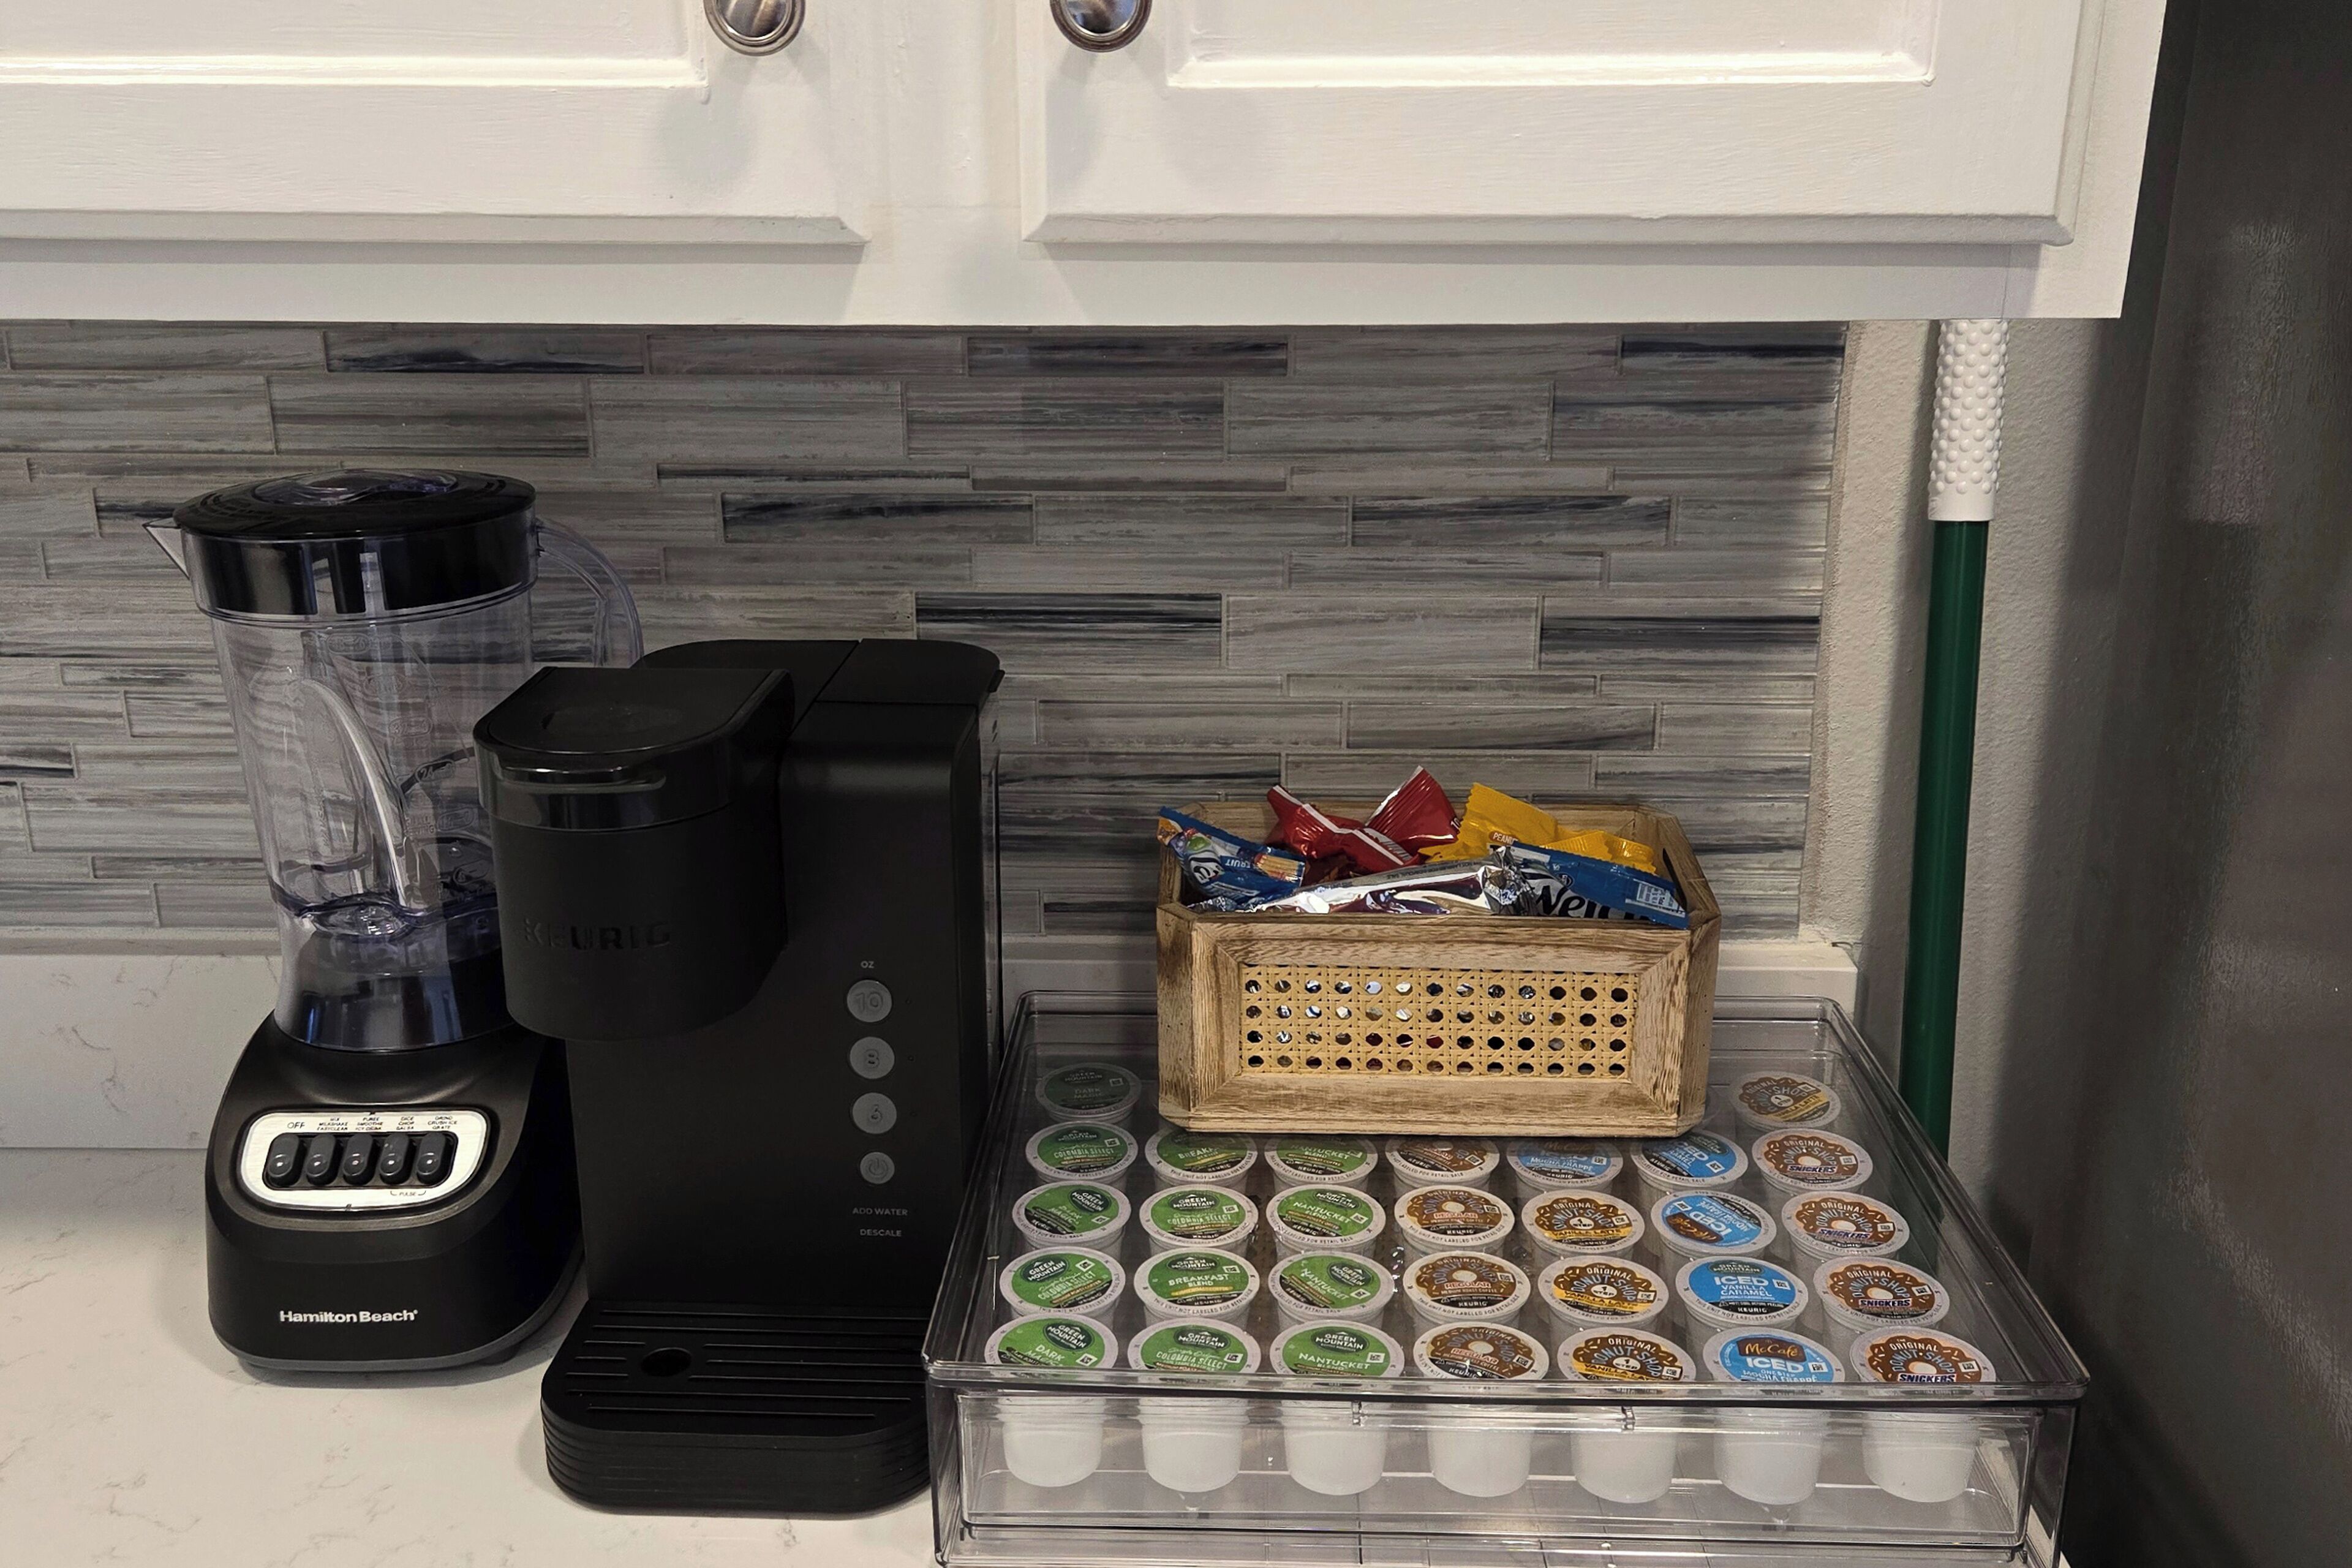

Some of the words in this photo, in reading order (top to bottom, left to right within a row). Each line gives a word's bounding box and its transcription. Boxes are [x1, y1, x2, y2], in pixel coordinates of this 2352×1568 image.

[1225, 859, 1251, 869] FRUIT
[524, 918, 673, 950] KEURIG
[855, 992, 883, 1012] 10
[865, 1048, 880, 1068] 8
[1746, 1080, 1777, 1094] ORIGINAL
[1772, 1085, 1807, 1098] SHOP
[1054, 1149, 1089, 1159] COLOMBIA
[1290, 1144, 1351, 1161] NANTUCKET
[1297, 1165, 1324, 1175] KEURIG
[1789, 1164, 1837, 1174] SNICKERS
[1072, 1191, 1104, 1212] MOUNTAIN
[1082, 1192, 1104, 1206] GREEN
[1316, 1193, 1356, 1209] MOUNTAIN
[1325, 1191, 1354, 1202] GREEN
[1422, 1194, 1452, 1215] DONUT
[1456, 1194, 1485, 1214] SHOP
[1553, 1201, 1598, 1210] ORIGINAL
[1820, 1201, 1865, 1215] ORIGINAL
[1205, 1213, 1232, 1222] SELECT
[1293, 1201, 1352, 1224] NANTUCKET
[1305, 1210, 1329, 1220] BLEND
[1583, 1208, 1615, 1229] SHOP
[1689, 1211, 1733, 1236] ICED
[1815, 1208, 1847, 1228] DONUT
[1848, 1212, 1874, 1233] SHOP
[859, 1229, 902, 1237] DESCALE
[1292, 1224, 1318, 1236] KEURIG
[1818, 1228, 1871, 1240] SNICKERS
[1028, 1261, 1066, 1281] MOUNTAIN
[1029, 1260, 1056, 1275] GREEN
[1341, 1266, 1366, 1280] GREEN
[1432, 1262, 1463, 1285] DONUT
[1467, 1263, 1498, 1284] SHOP
[1586, 1267, 1632, 1281] ORIGINAL
[1846, 1269, 1893, 1278] ORIGINAL
[1168, 1273, 1231, 1287] BREAKFAST
[1330, 1265, 1365, 1286] MOUNTAIN
[1714, 1275, 1769, 1286] ICED
[1038, 1280, 1073, 1300] COLOMBIA
[1073, 1270, 1096, 1285] SELECT
[1300, 1267, 1351, 1300] NANTUCKET
[1570, 1274, 1611, 1292] DONUT
[1613, 1278, 1637, 1302] SHOP
[1849, 1276, 1876, 1298] DONUT
[1877, 1277, 1912, 1299] SHOP
[1564, 1291, 1605, 1304] VANILLA
[1607, 1298, 1639, 1308] LATTE
[1860, 1298, 1912, 1307] SNICKERS
[279, 1310, 358, 1323] Hamilton
[1191, 1306, 1219, 1315] LABELED
[1047, 1326, 1088, 1349] MOUNTAIN
[1058, 1325, 1086, 1341] GREEN
[1188, 1333, 1219, 1342] GREEN
[1324, 1333, 1358, 1343] GREEN
[1446, 1332, 1494, 1348] DONUT
[1471, 1327, 1518, 1343] ORIGINAL
[1177, 1335, 1226, 1348] MOUNTAIN
[1315, 1336, 1364, 1350] MOUNTAIN
[1608, 1337, 1657, 1354] ORIGINAL
[1889, 1341, 1939, 1352] ORIGINAL
[1035, 1344, 1066, 1362] DARK
[1450, 1348, 1499, 1365] REGULAR
[1744, 1342, 1799, 1359] McCafé
[1025, 1350, 1064, 1366] MAGIC
[1155, 1351, 1196, 1363] COLOMBIA
[1198, 1357, 1229, 1370] SELECT
[1298, 1352, 1371, 1370] NANTUCKET
[1591, 1345, 1635, 1365] DONUT
[1636, 1351, 1664, 1378] SHOP
[1746, 1357, 1804, 1373] ICED
[1889, 1349, 1920, 1373] DONUT
[1923, 1351, 1956, 1374] SHOP
[1316, 1363, 1345, 1371] BLEND
[1448, 1367, 1480, 1378] KEURIG
[1480, 1361, 1500, 1371] COFFEE
[1584, 1363, 1628, 1377] VANILLA
[1742, 1370, 1777, 1382] MOCHA
[1898, 1373, 1956, 1383] SNICKERS
